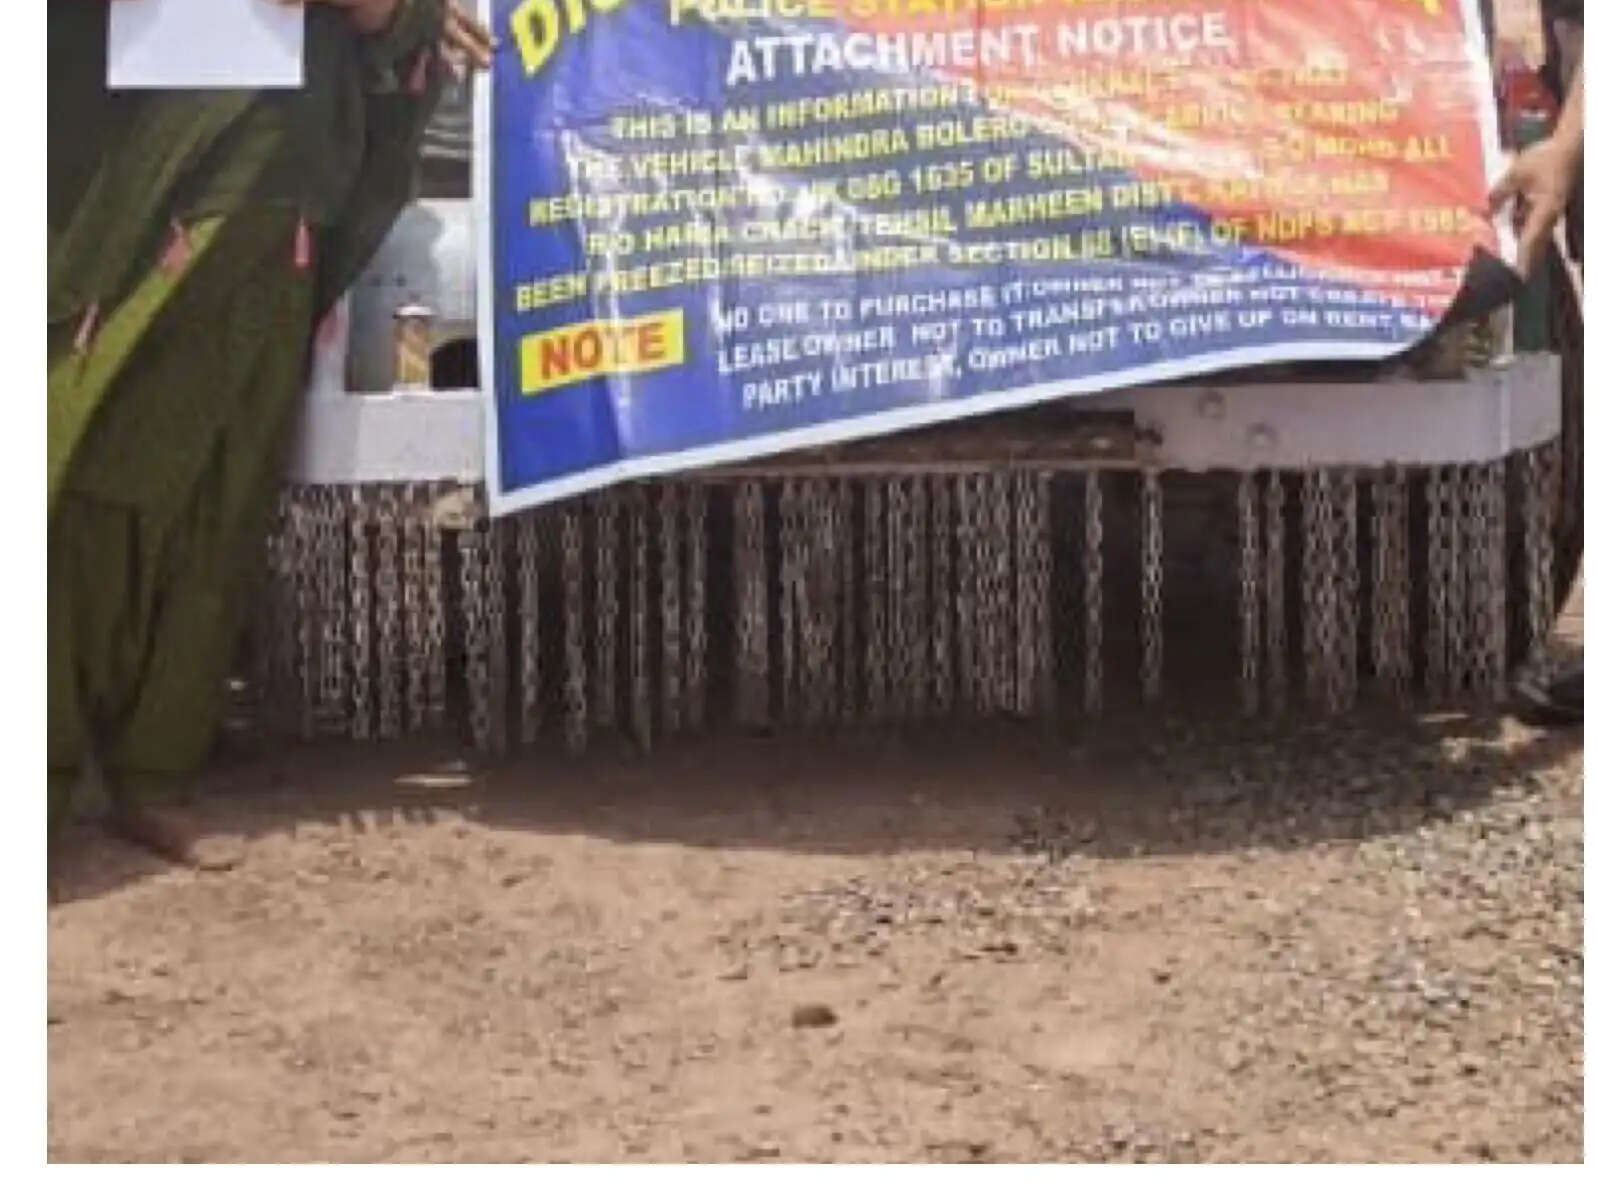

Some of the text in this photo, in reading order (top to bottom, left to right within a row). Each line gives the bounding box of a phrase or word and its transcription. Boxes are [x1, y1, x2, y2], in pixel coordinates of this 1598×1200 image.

[726, 10, 1233, 87] ATTACHMENT NOTICE
[609, 110, 677, 140] THIS
[539, 321, 668, 381] NOTE
[742, 368, 822, 413] PARTY
